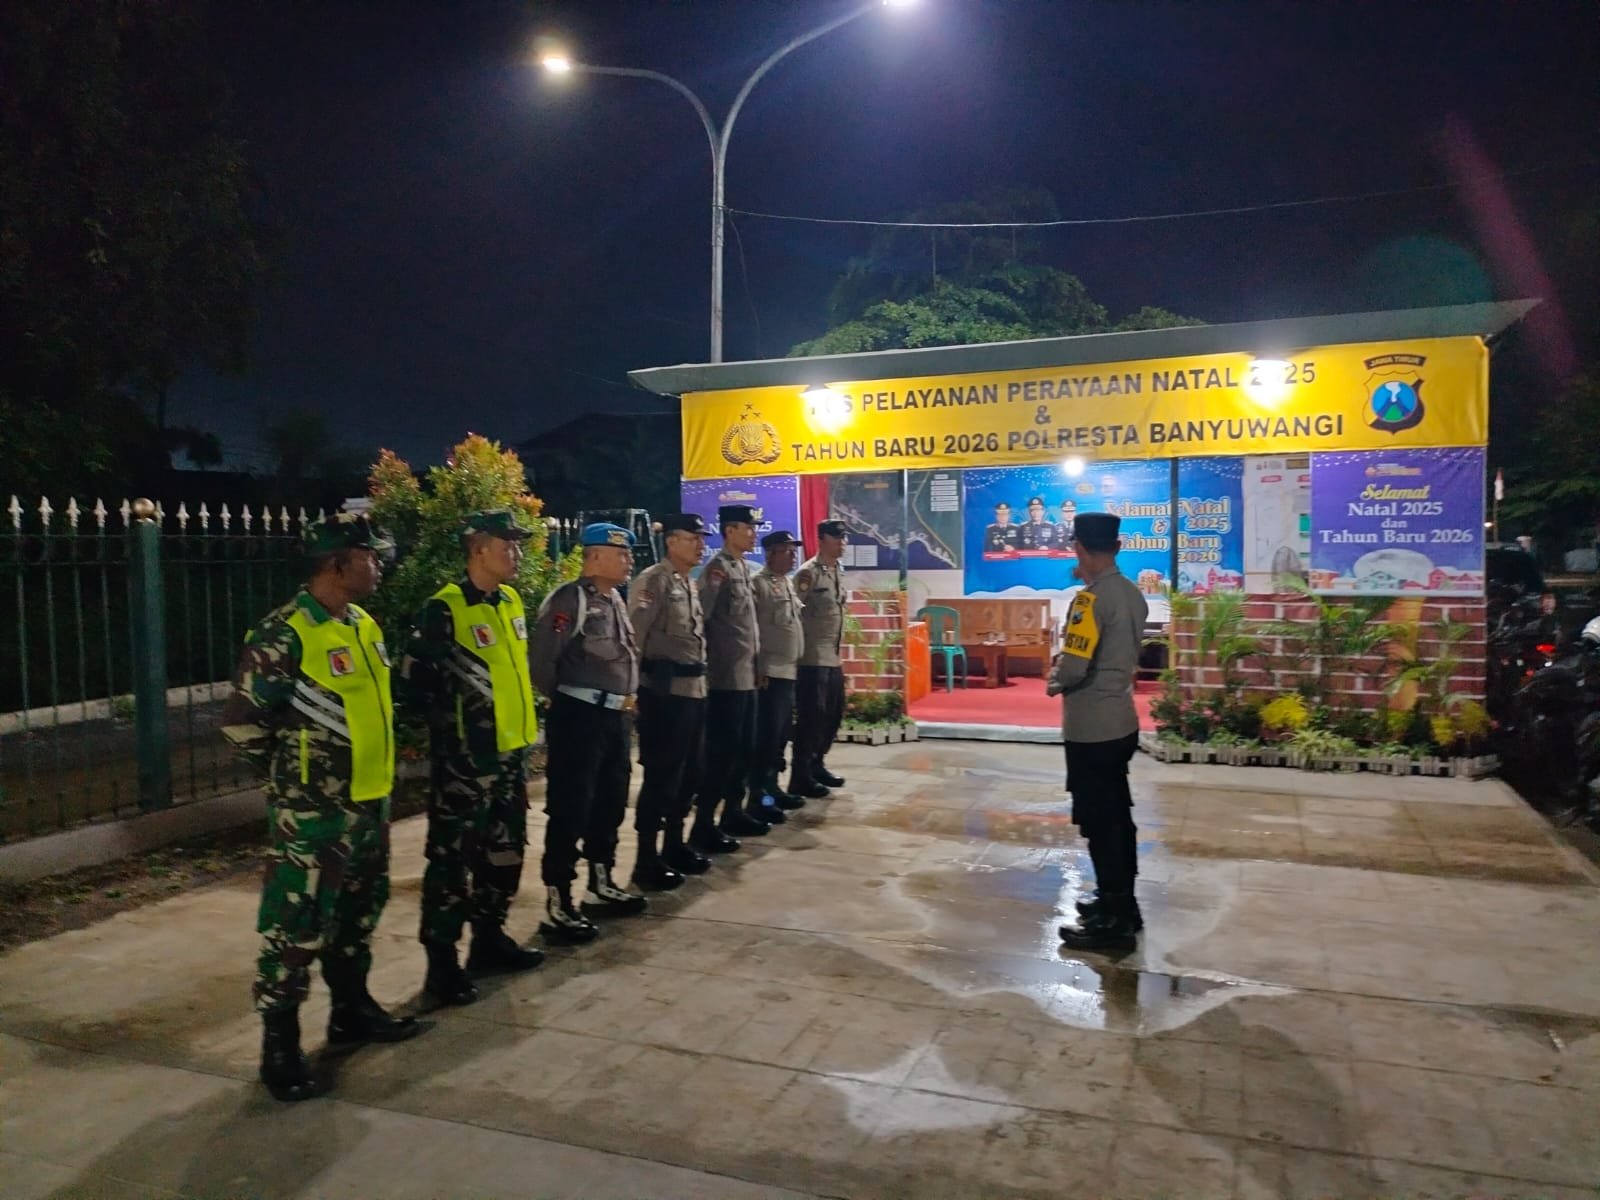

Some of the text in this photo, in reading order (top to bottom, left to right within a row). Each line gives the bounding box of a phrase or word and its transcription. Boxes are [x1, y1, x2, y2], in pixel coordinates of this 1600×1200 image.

[862, 384, 999, 412] PELAYANAN
[1007, 372, 1142, 403] PERAYAAN
[1152, 367, 1240, 393] NATAL
[1250, 362, 1315, 386] 225
[1034, 405, 1051, 425] &
[791, 414, 1344, 461] TAHUN BARU 2026 POLRESTA BANYUWANGI
[1360, 484, 1431, 500] Selamat
[1178, 499, 1229, 516] Natal
[1348, 501, 1444, 516] Natal 2025
[1188, 517, 1229, 532] 2025
[1381, 518, 1408, 529] dan
[1177, 533, 1219, 549] Baru
[1319, 529, 1473, 544] Tahun Baru 2026
[1178, 550, 1219, 562] 2026
